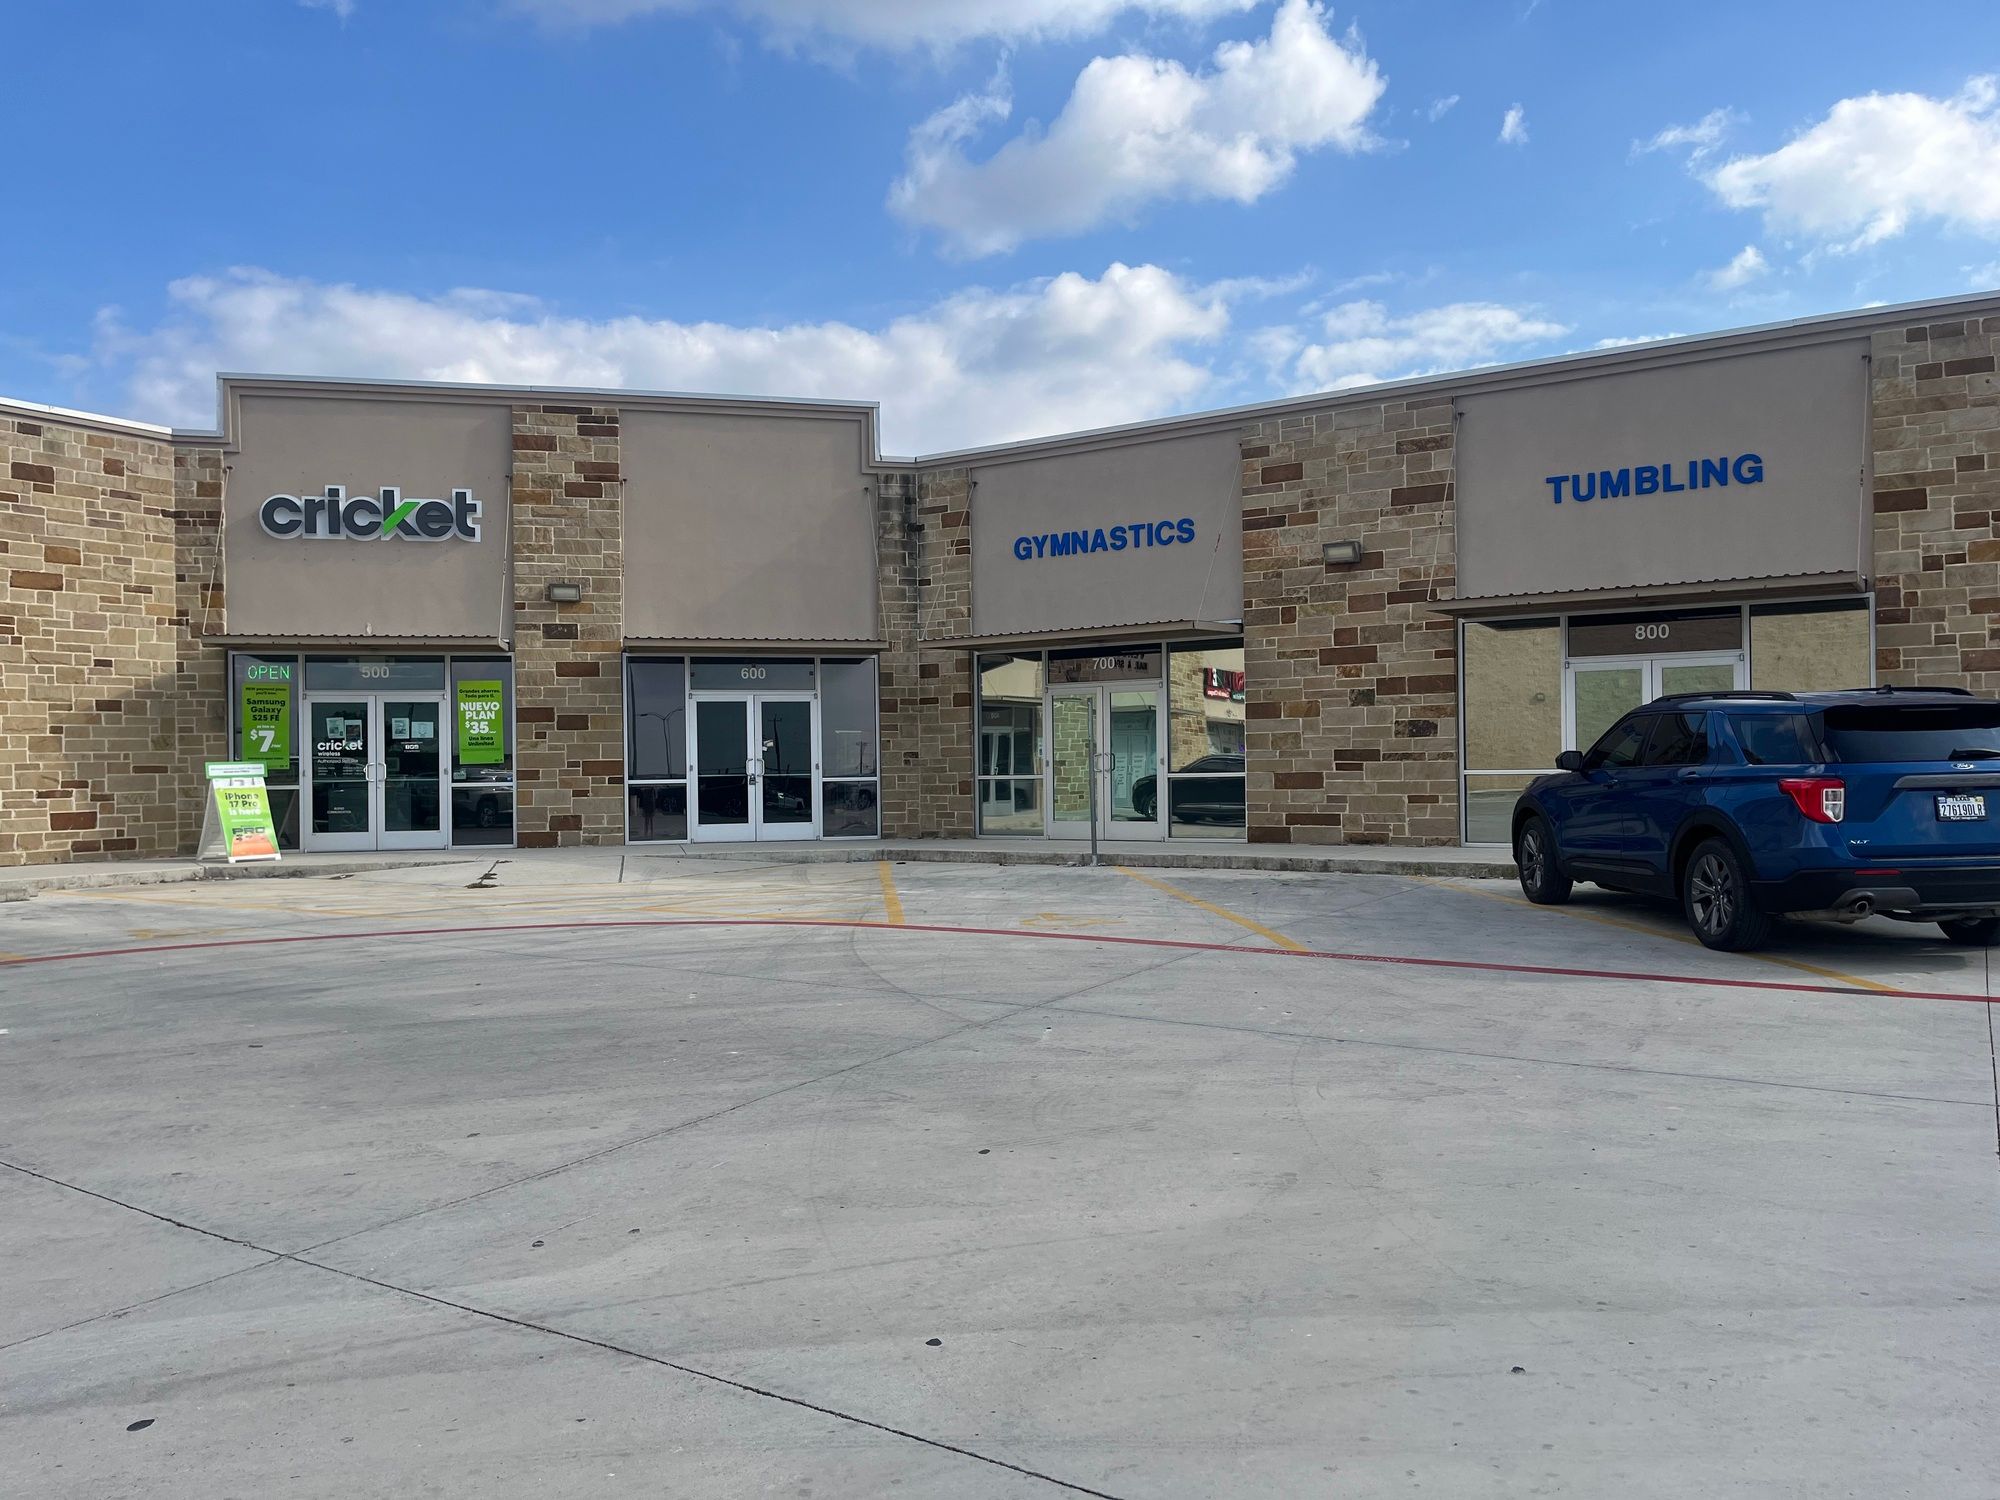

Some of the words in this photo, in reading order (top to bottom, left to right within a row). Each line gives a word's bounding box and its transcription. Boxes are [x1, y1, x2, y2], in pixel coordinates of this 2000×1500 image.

[1545, 453, 1764, 505] TUMBLING
[260, 485, 482, 542] cricket
[1013, 518, 1196, 561] GYMNASTICS
[1635, 624, 1670, 640] 800
[1092, 656, 1115, 670] 700
[247, 664, 290, 680] OPEN
[361, 665, 390, 679] 500
[741, 667, 766, 679] 600
[246, 698, 286, 707] Samsung
[460, 701, 500, 711] NUEVO
[250, 706, 282, 715] Galaxy
[465, 711, 496, 720] PLAN
[252, 714, 268, 722] S25
[270, 714, 280, 722] FE
[465, 720, 490, 734] $35
[250, 729, 275, 753] $7
[317, 740, 363, 751] cricket
[224, 793, 259, 801] iPhone
[241, 800, 258, 808] Pro
[1941, 803, 1984, 817] 27619DLR
[229, 808, 238, 816] is
[238, 807, 262, 816] here
[232, 826, 266, 834] PRO
